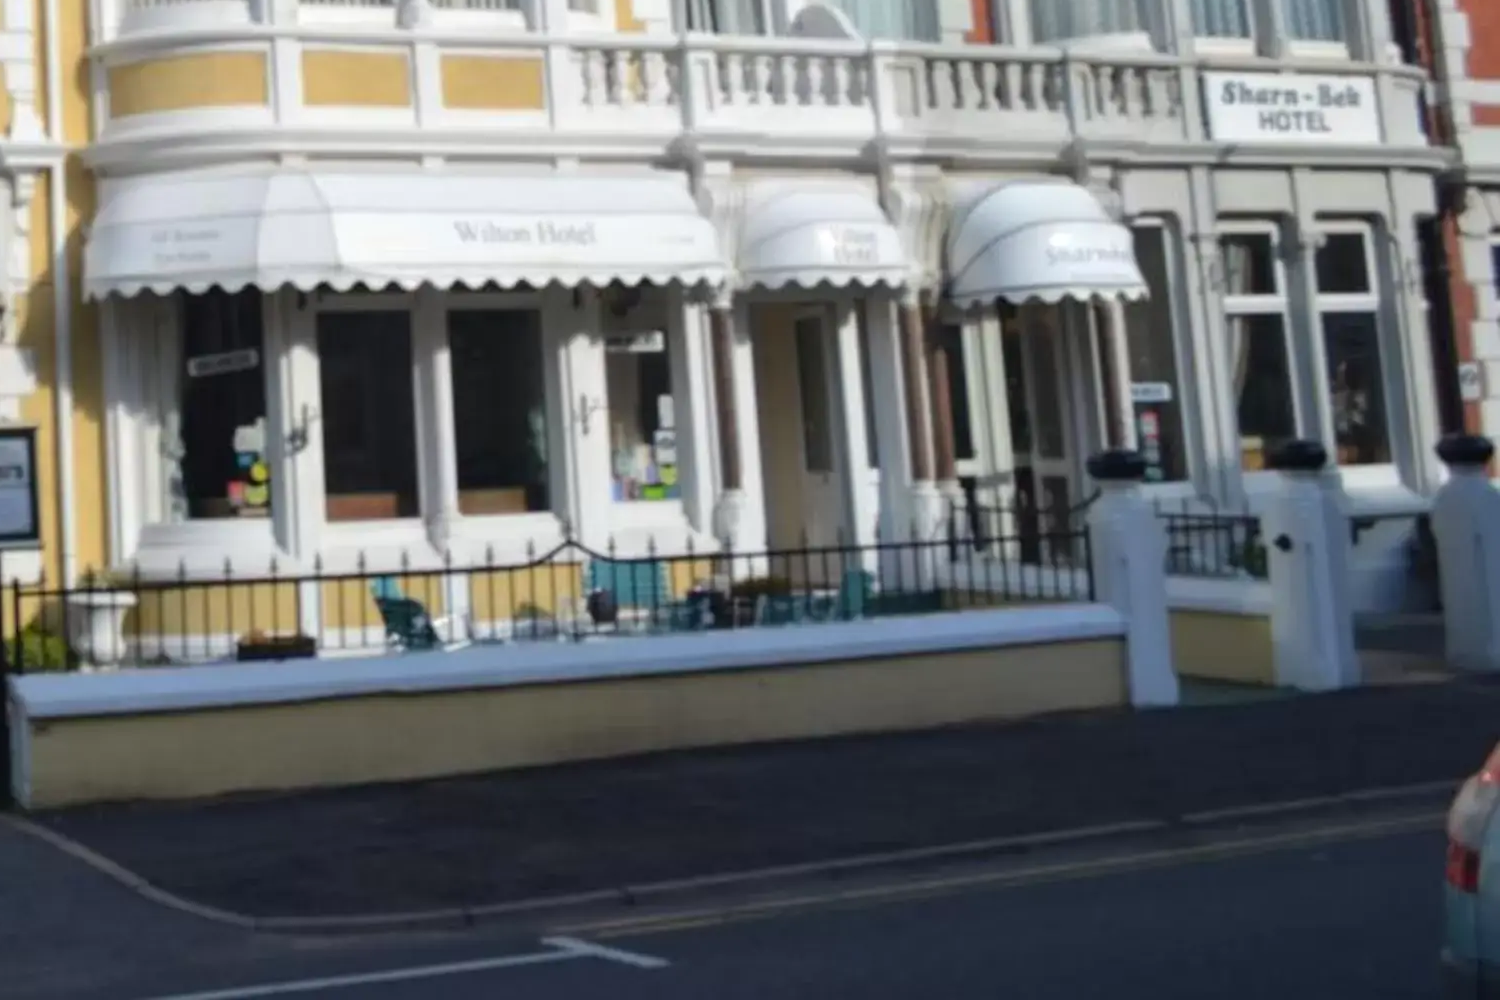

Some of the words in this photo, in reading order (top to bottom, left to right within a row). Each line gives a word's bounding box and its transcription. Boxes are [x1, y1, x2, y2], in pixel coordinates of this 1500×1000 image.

[1258, 110, 1331, 132] HOTEL
[453, 220, 531, 243] Wilton
[537, 219, 597, 245] Hotel
